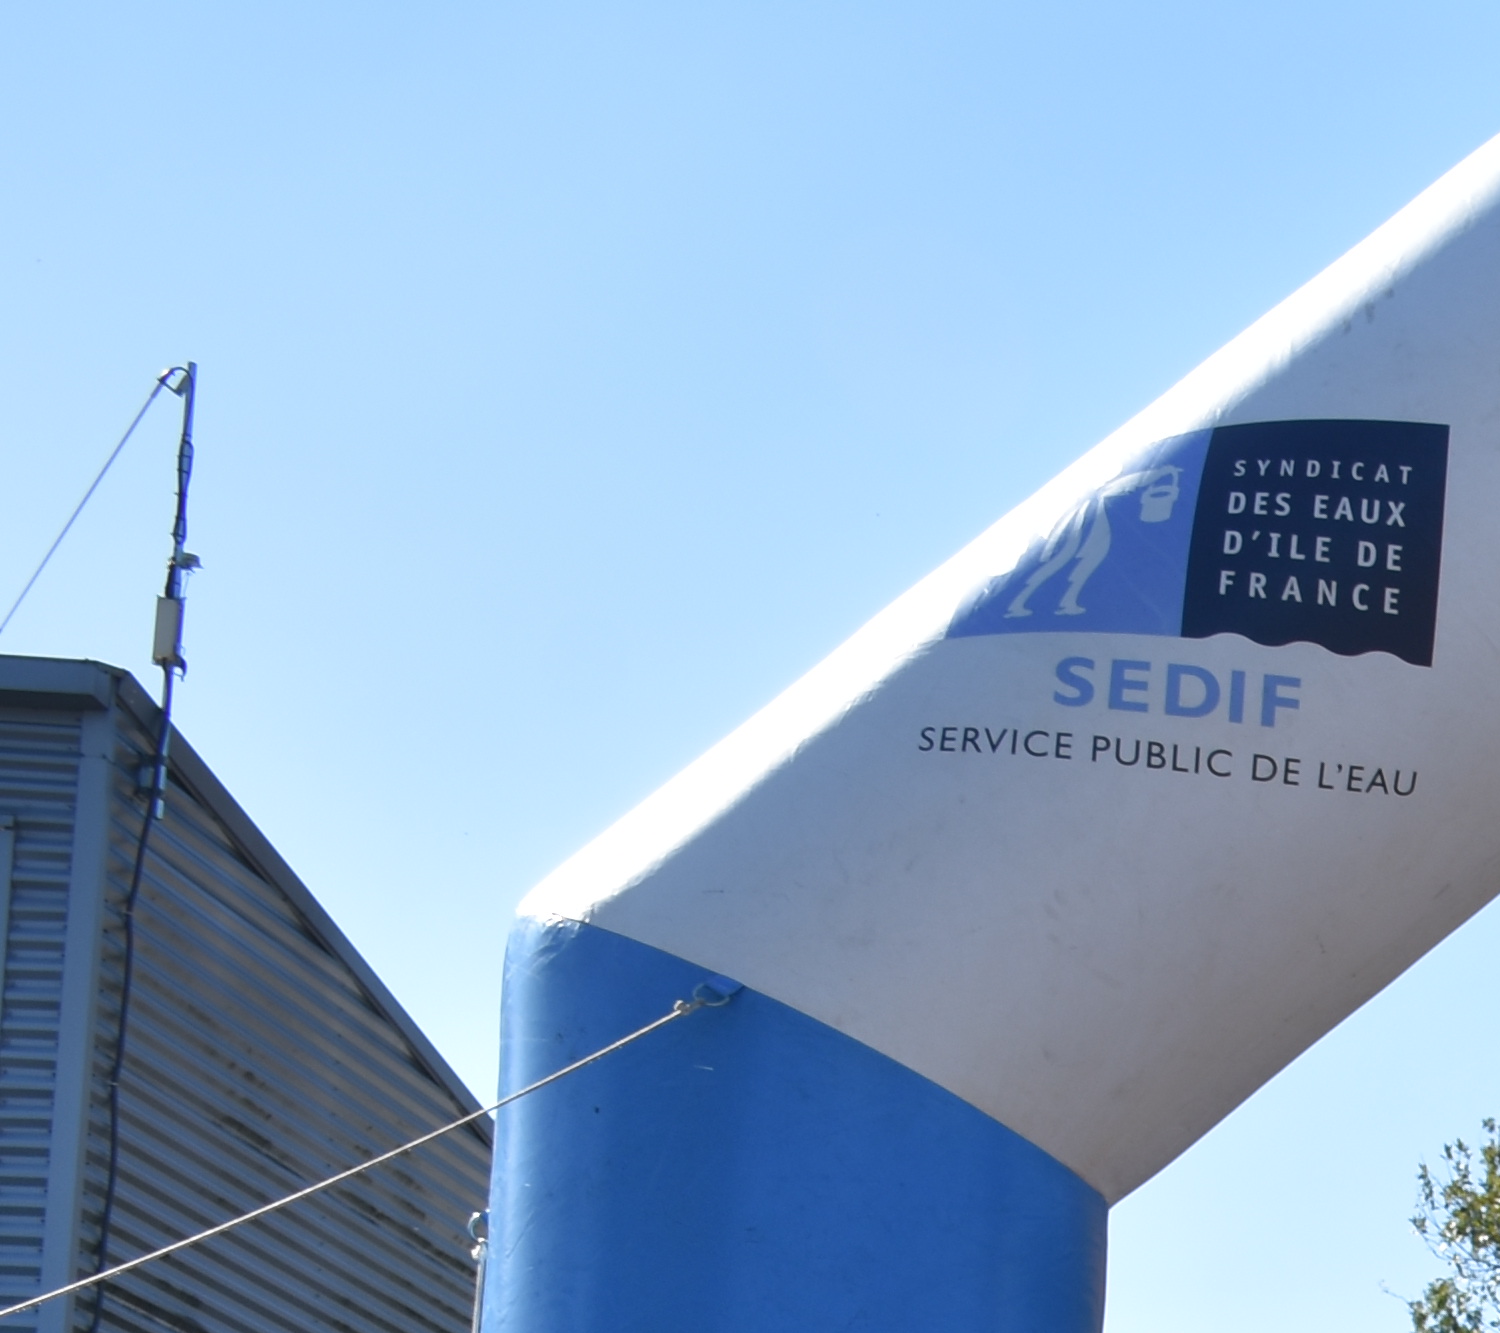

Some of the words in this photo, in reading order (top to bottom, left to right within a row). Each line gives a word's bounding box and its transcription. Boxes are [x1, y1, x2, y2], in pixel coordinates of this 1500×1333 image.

[1233, 458, 1413, 486] SYNDICAT
[1227, 491, 1292, 517] DES
[1312, 494, 1407, 528] EAUX
[1222, 530, 1332, 563] D'ILE
[1356, 542, 1404, 573] DE
[1218, 569, 1401, 616] FRANCE
[1052, 655, 1303, 729] SEDIF
[917, 725, 1074, 761] SERVICE
[1090, 735, 1234, 779] PUBLIC
[1251, 753, 1301, 786] DE
[1318, 760, 1420, 797] L'EAU
